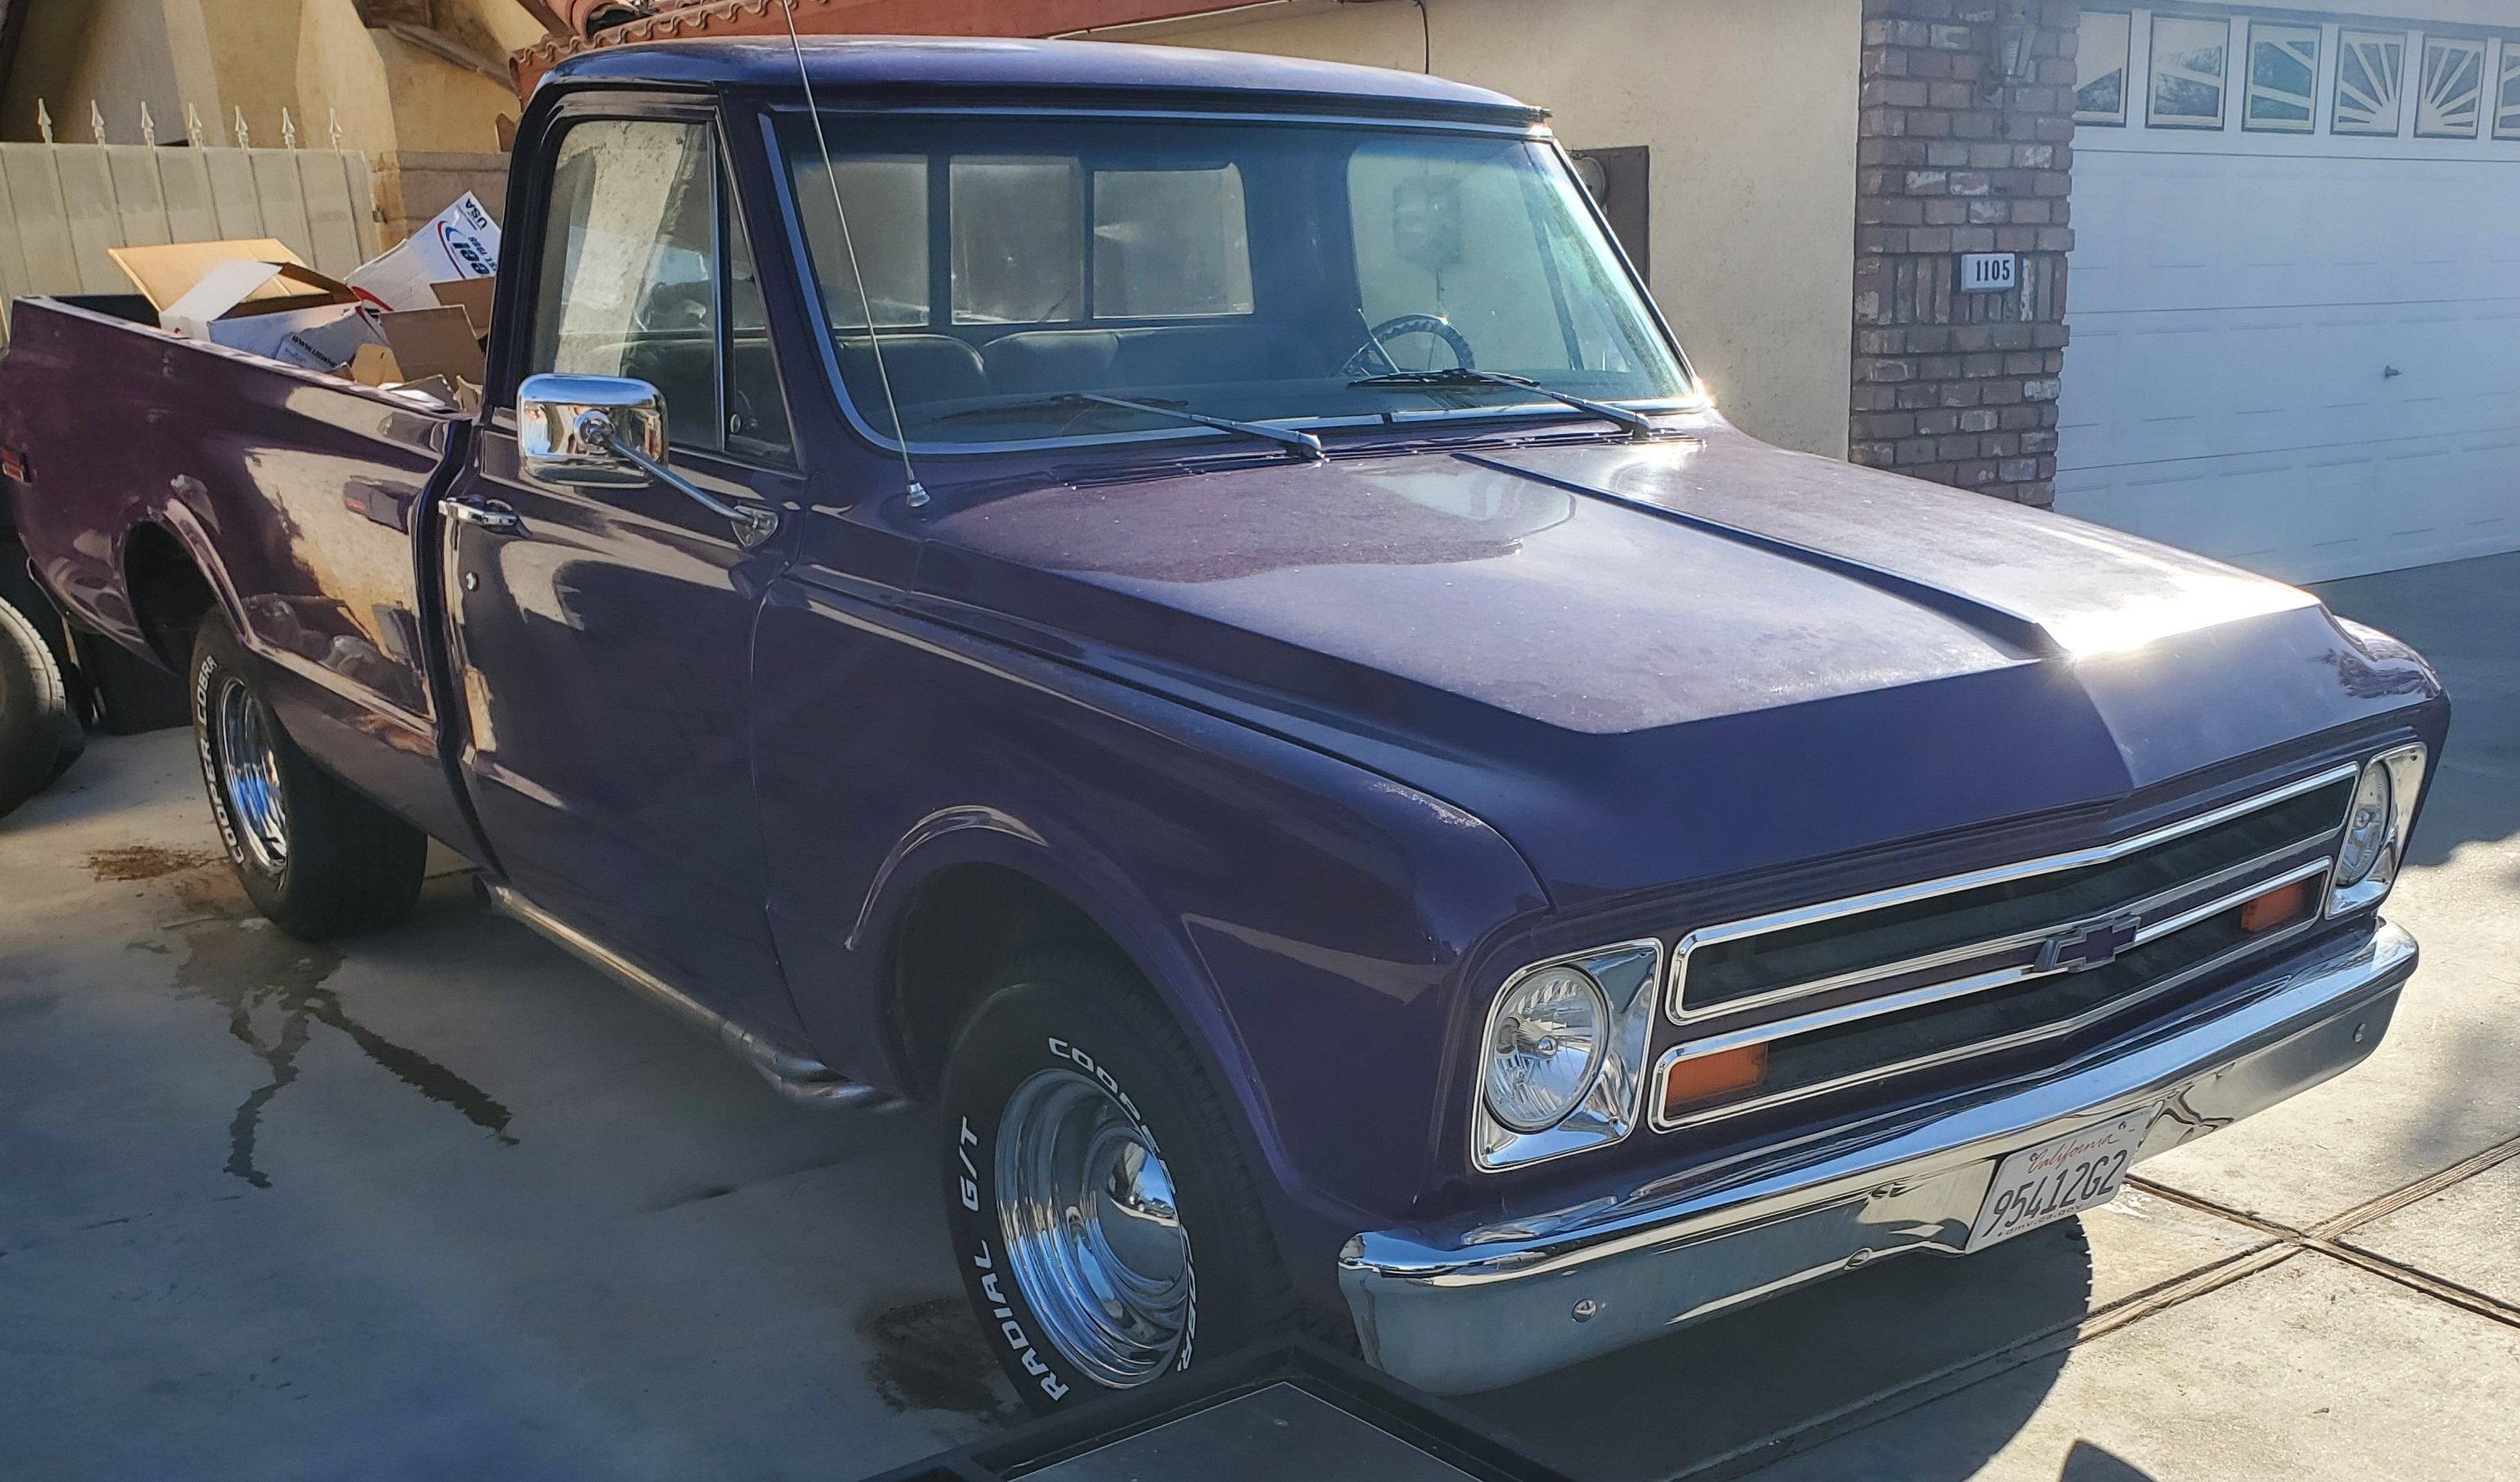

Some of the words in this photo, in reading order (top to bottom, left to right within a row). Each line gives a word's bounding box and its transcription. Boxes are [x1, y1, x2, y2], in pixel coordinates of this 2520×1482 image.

[465, 198, 487, 229] USA
[452, 242, 490, 275] eel
[1976, 260, 2011, 282] 1105
[196, 654, 218, 726] COBRA
[201, 738, 246, 864] COOPER
[959, 1115, 979, 1213] G/T
[2027, 1129, 2120, 1174] California
[1981, 1149, 2128, 1237] 95412G2
[2005, 1203, 2084, 1235] dmv.ca.gov
[973, 1238, 1069, 1401] RADIAL
